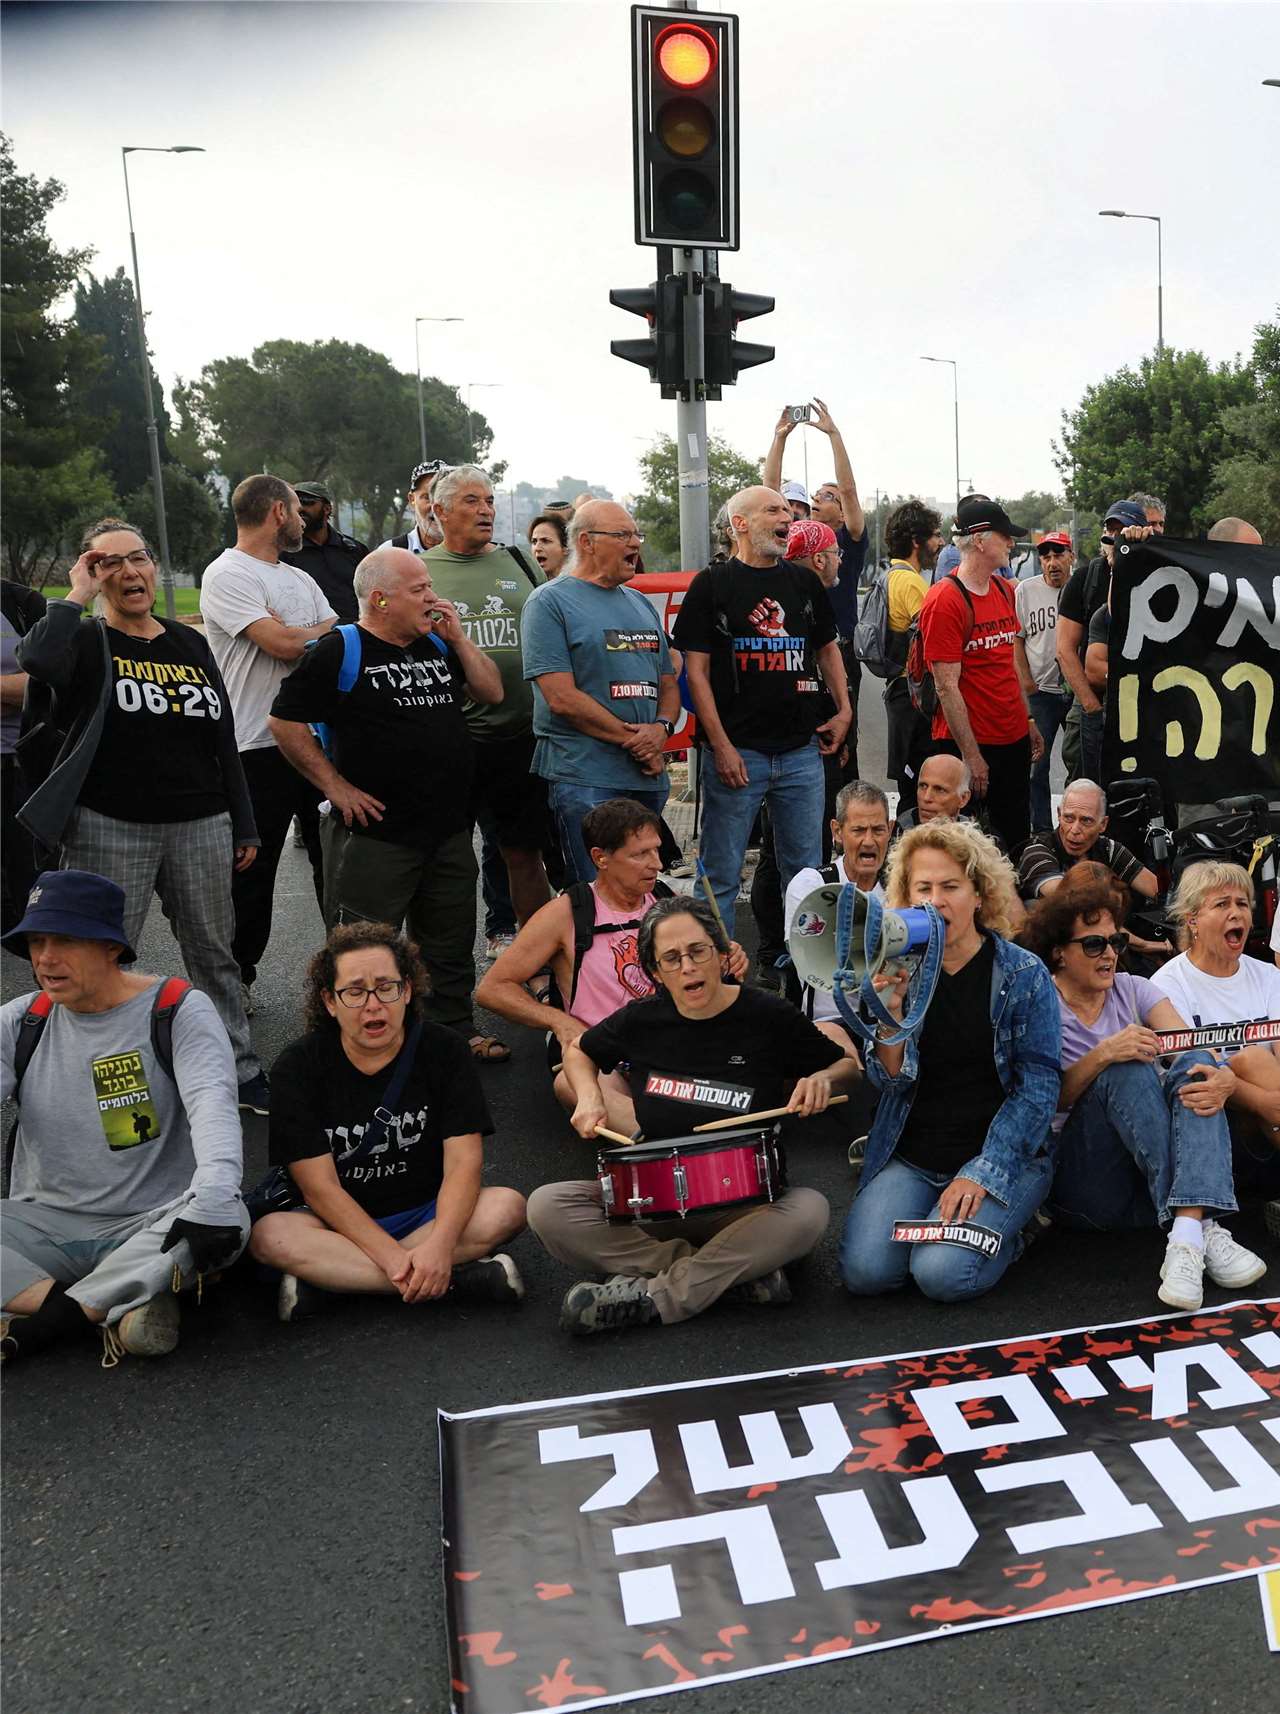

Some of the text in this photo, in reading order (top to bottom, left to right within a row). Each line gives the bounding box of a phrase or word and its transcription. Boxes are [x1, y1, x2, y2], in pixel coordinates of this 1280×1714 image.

[1029, 606, 1057, 637] BOS
[115, 678, 222, 721] 06:29
[393, 693, 454, 708] באוקטובר
[611, 685, 631, 697] 7.10
[1159, 1026, 1242, 1052] לא שכחנו את .10
[1247, 1024, 1267, 1040] 7.10
[94, 1056, 141, 1078] נתניהו
[103, 1075, 138, 1092] בוגד
[649, 1077, 751, 1109] לא שכחנו את 7.10
[99, 1091, 150, 1111] בלוחמים
[897, 1226, 998, 1254] לא שכחנו את 7.10
[538, 1402, 854, 1512] של
